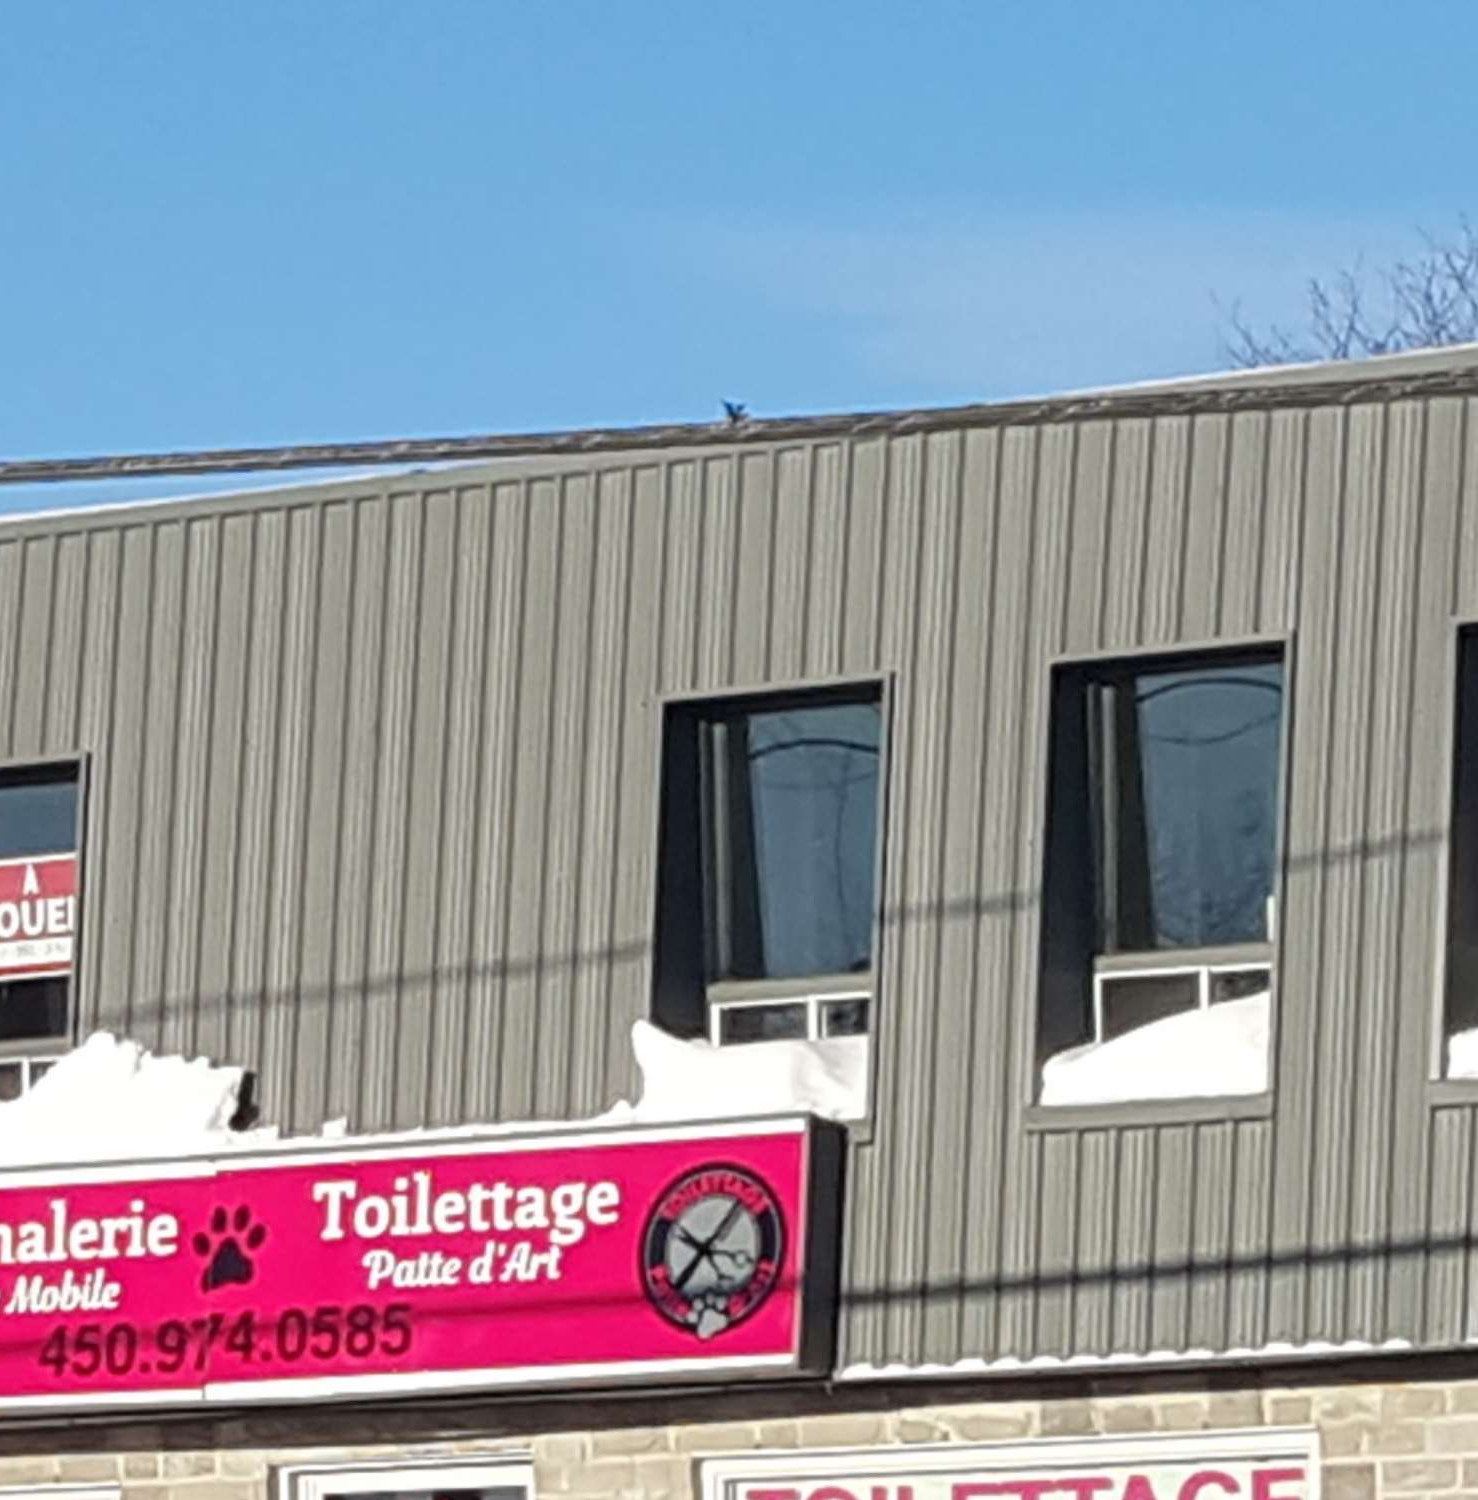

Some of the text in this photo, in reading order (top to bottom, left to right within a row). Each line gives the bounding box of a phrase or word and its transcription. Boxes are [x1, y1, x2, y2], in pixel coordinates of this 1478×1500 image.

[312, 1171, 620, 1246] Toilettage
[4, 1268, 121, 1315] Mobile
[361, 1240, 562, 1290] Patte d'Art
[38, 1303, 413, 1377] 450.974.0585
